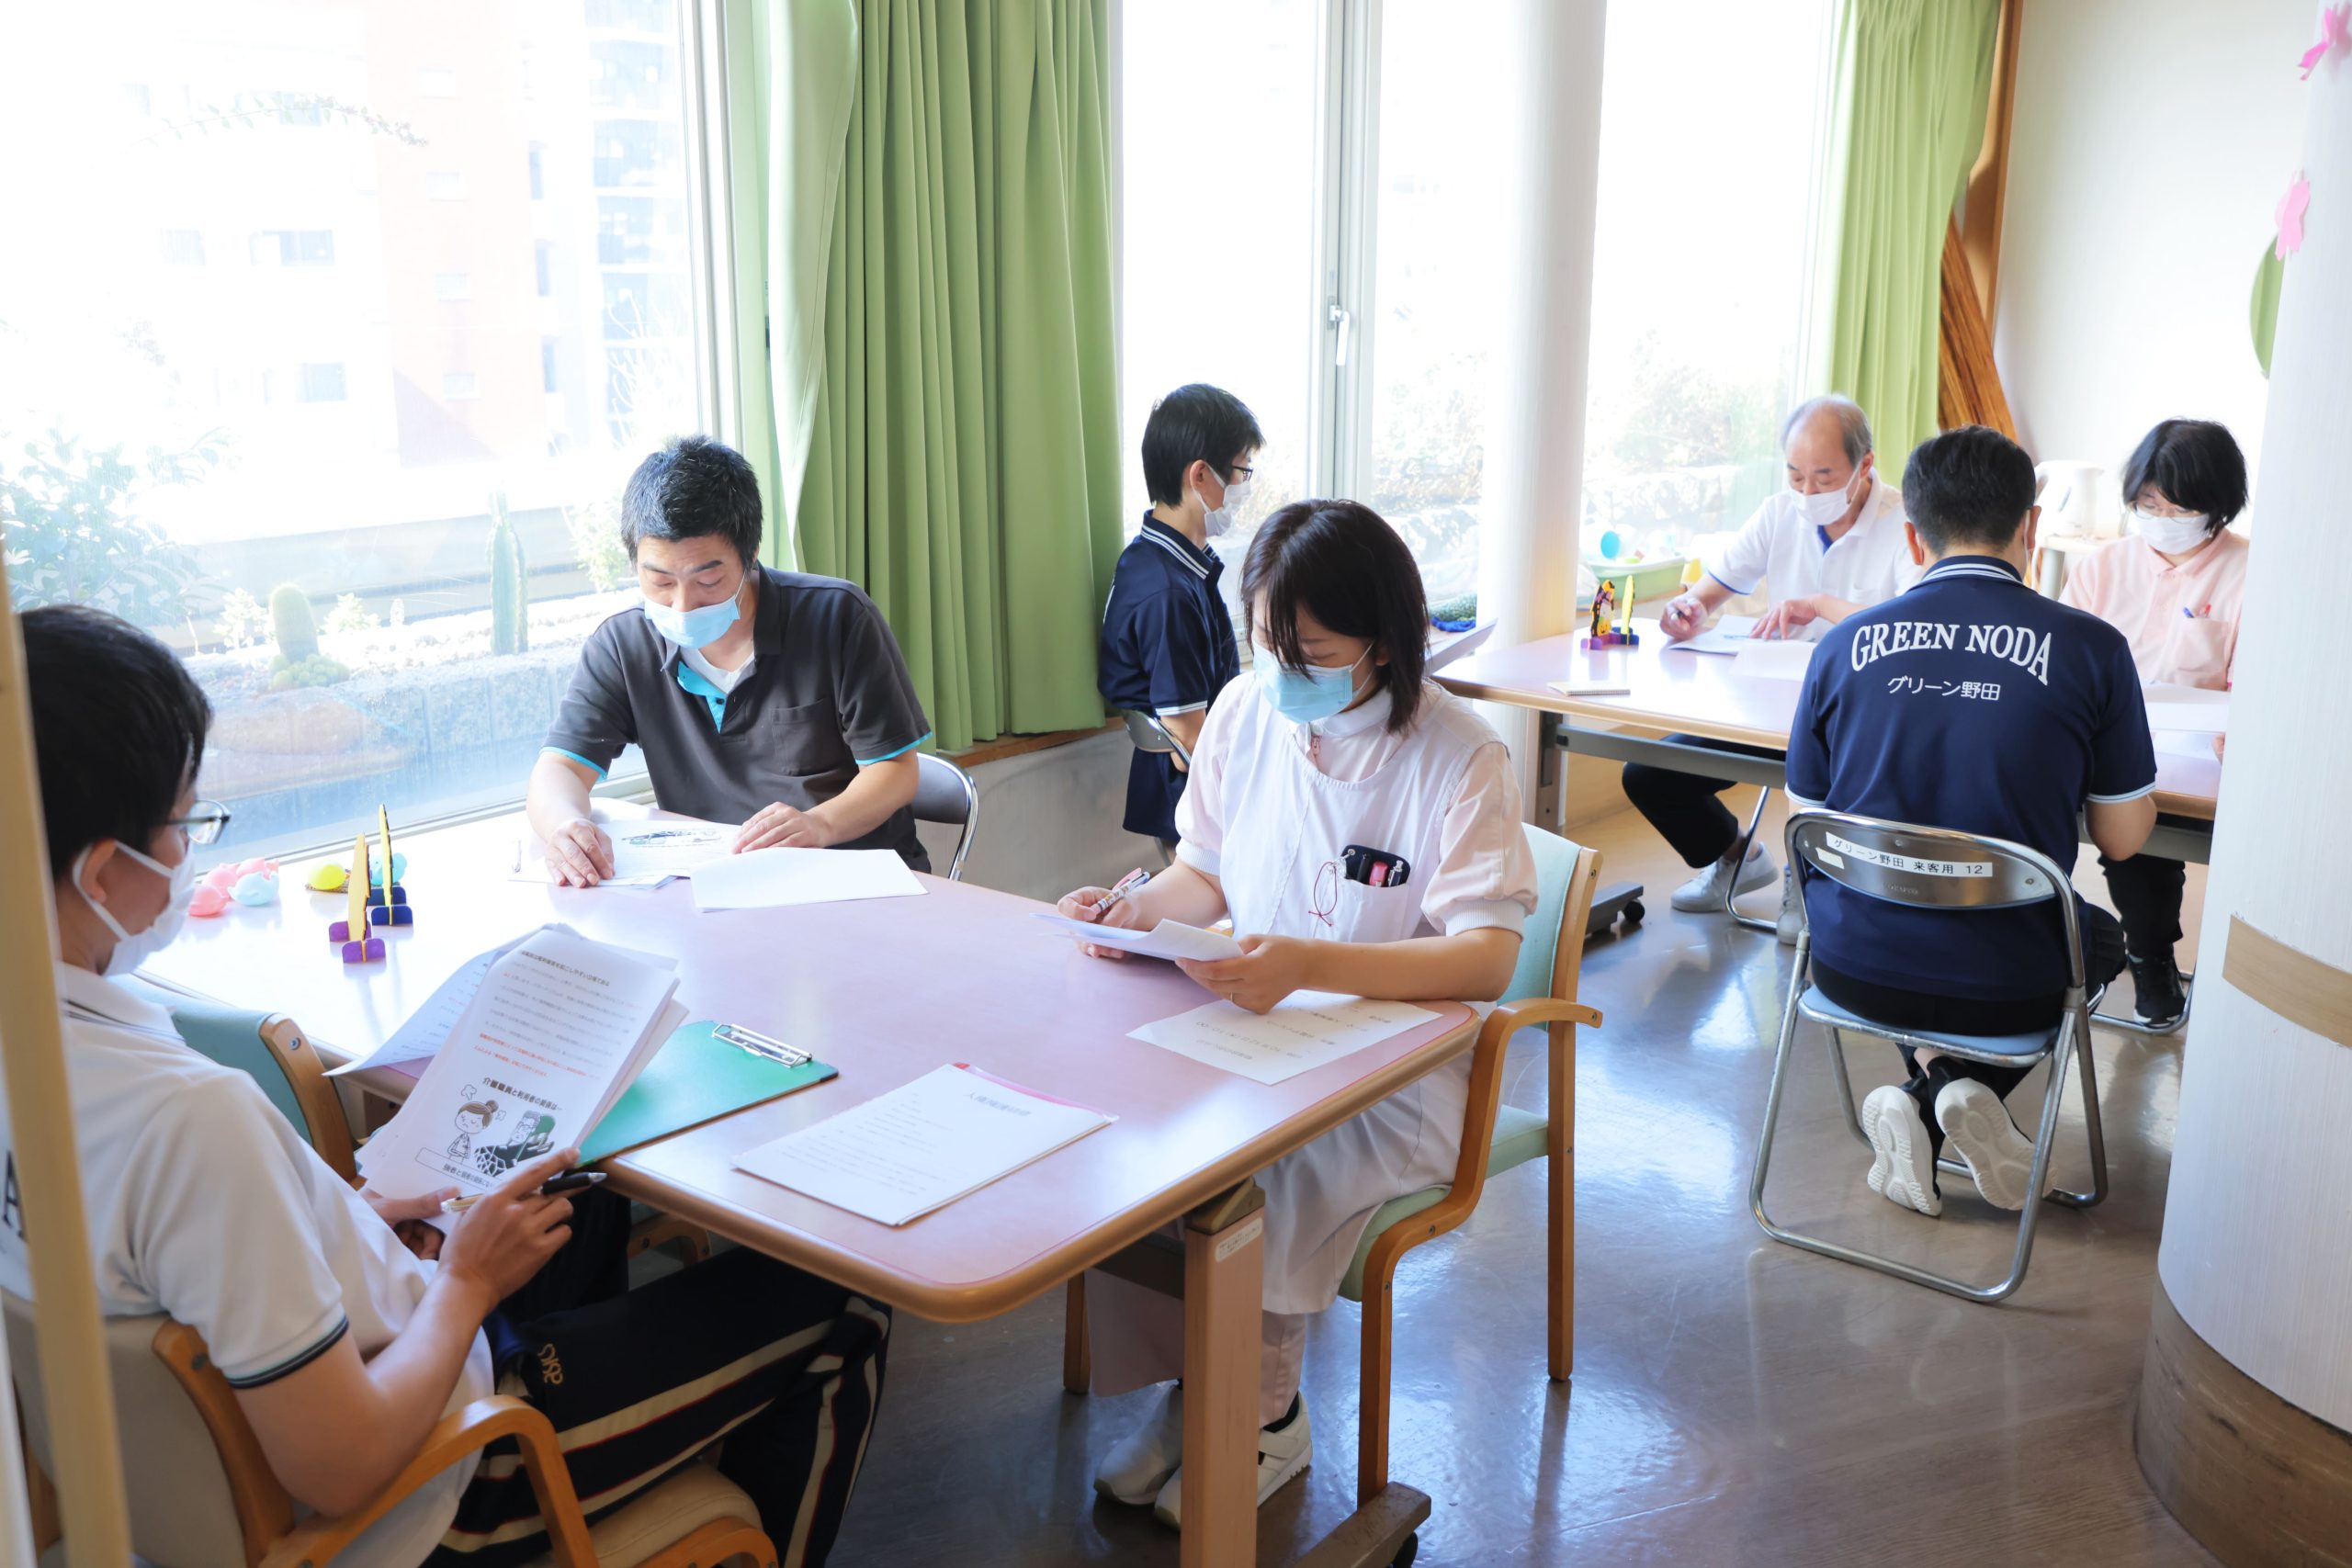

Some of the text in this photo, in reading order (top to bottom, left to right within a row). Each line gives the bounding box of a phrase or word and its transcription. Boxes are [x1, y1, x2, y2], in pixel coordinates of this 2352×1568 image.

[1851, 621, 2052, 686] GREEN NODA
[1887, 675, 2001, 701] グリーン野田
[1834, 838, 1983, 874] グリーン野田 来客用 12
